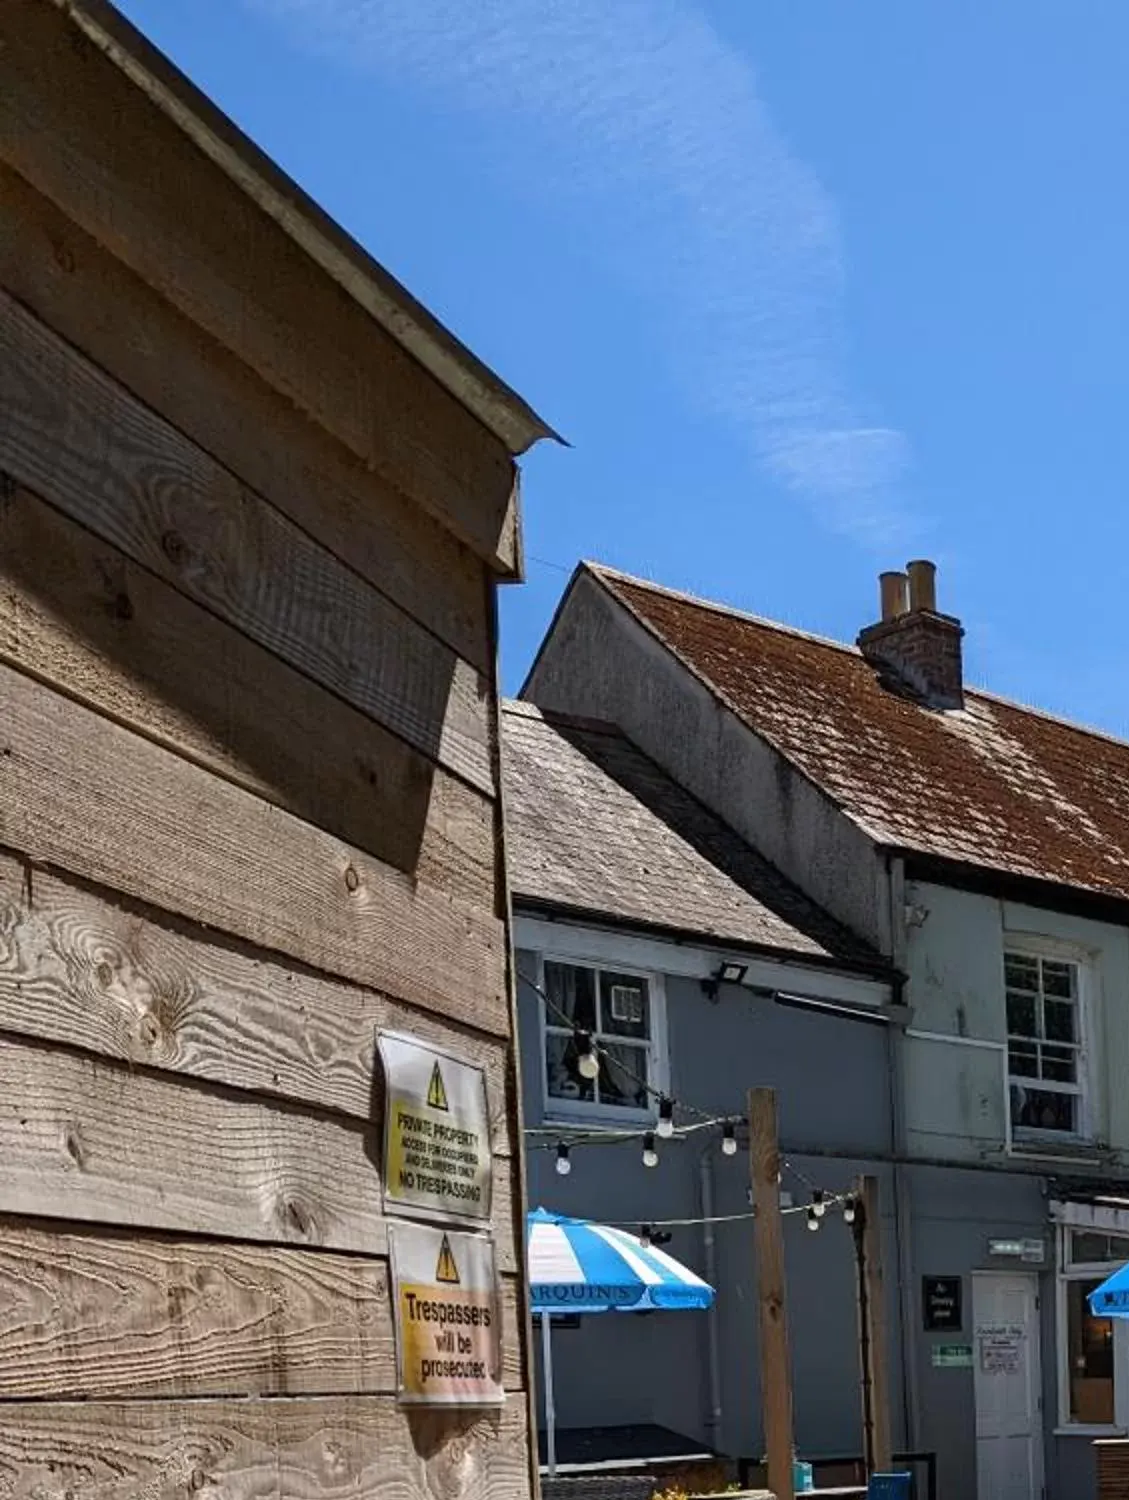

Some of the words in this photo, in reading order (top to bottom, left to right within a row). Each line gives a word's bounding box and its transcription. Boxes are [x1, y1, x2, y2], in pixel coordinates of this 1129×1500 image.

[398, 1112, 433, 1137] PRIVATE
[434, 1123, 479, 1148] PROPERTY
[399, 1167, 415, 1189] NO
[416, 1173, 481, 1203] TRESPASSING
[404, 1292, 491, 1329] Trespassers
[434, 1331, 455, 1353] will
[457, 1332, 472, 1354] be
